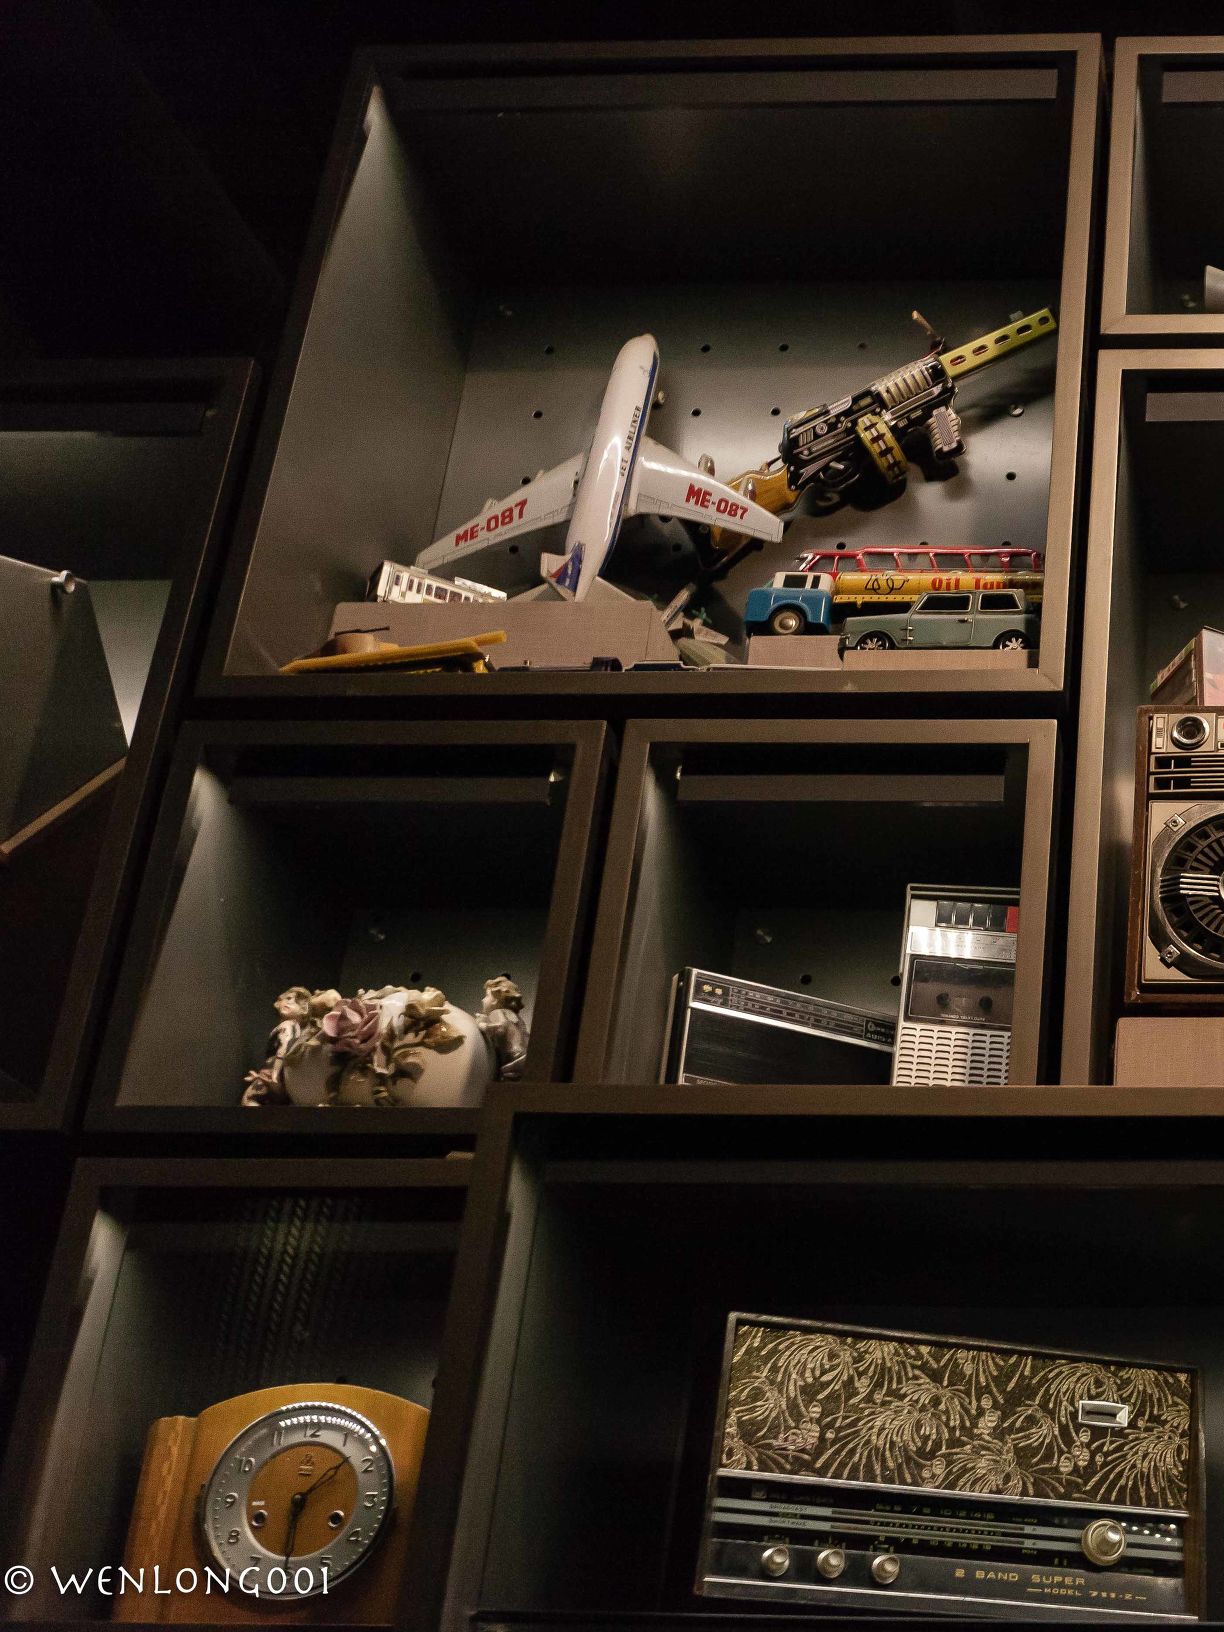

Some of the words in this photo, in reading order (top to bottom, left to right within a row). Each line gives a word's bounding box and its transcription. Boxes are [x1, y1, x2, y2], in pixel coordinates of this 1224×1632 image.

[685, 483, 749, 520] ME-087
[455, 498, 528, 547] ME-087
[931, 577, 960, 591] Oil
[303, 1422, 321, 1439] 12
[361, 1456, 375, 1474] 2
[225, 1491, 239, 1508] 9
[364, 1491, 379, 1508] 3
[227, 1528, 241, 1544] 8
[976, 1570, 1018, 1581] BAND
[1031, 1574, 1086, 1586] SUPER
[1044, 1587, 1082, 1596] MODEL
